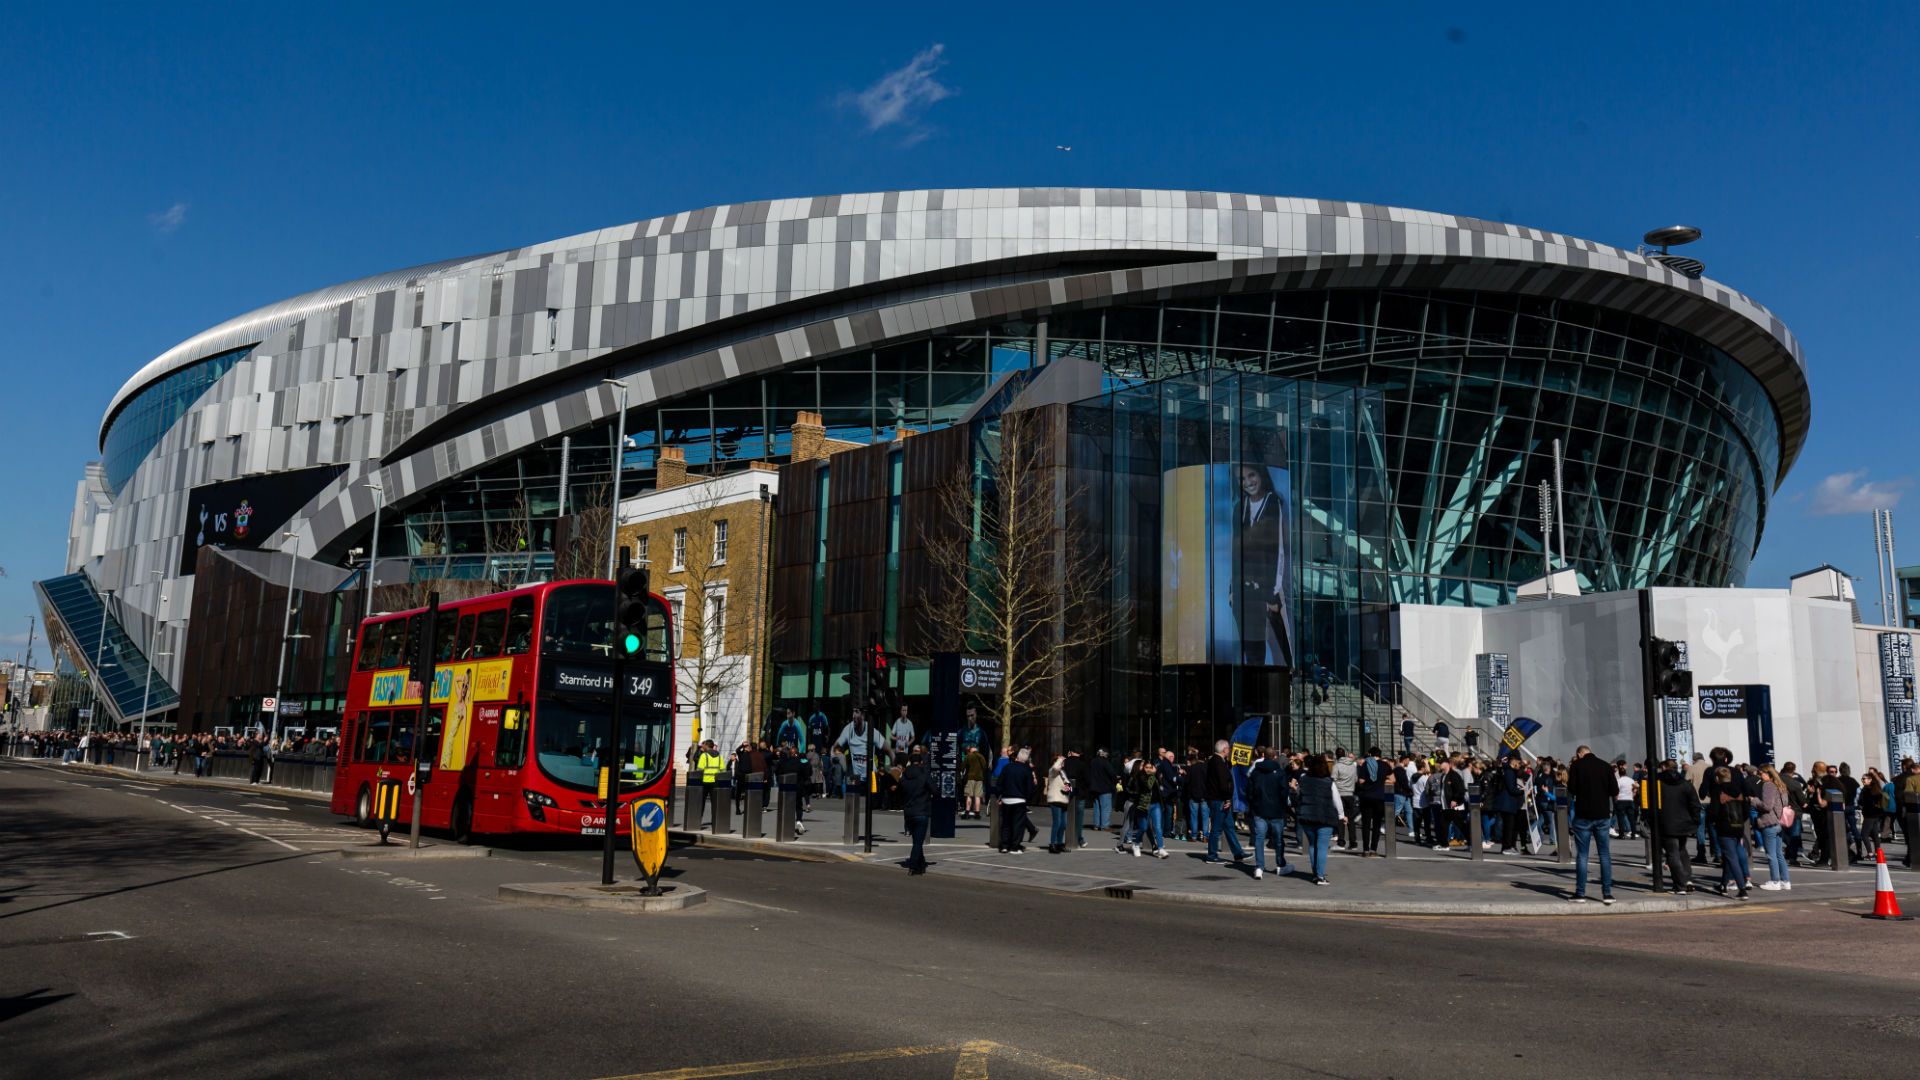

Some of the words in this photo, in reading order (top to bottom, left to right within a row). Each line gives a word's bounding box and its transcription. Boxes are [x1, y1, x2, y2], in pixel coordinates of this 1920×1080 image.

[214, 512, 228, 533] VS
[961, 658, 976, 667] BAG
[976, 659, 1001, 669] POLICY
[1885, 633, 1897, 677] TERVETULOA
[1890, 633, 1901, 677] WILLKOMMEN
[559, 672, 601, 688] Stamford
[629, 676, 653, 696] 349
[1699, 688, 1714, 697] BAG
[1714, 688, 1739, 697] POLICY
[1233, 748, 1249, 759] ASK
[1669, 733, 1678, 760] WELCO
